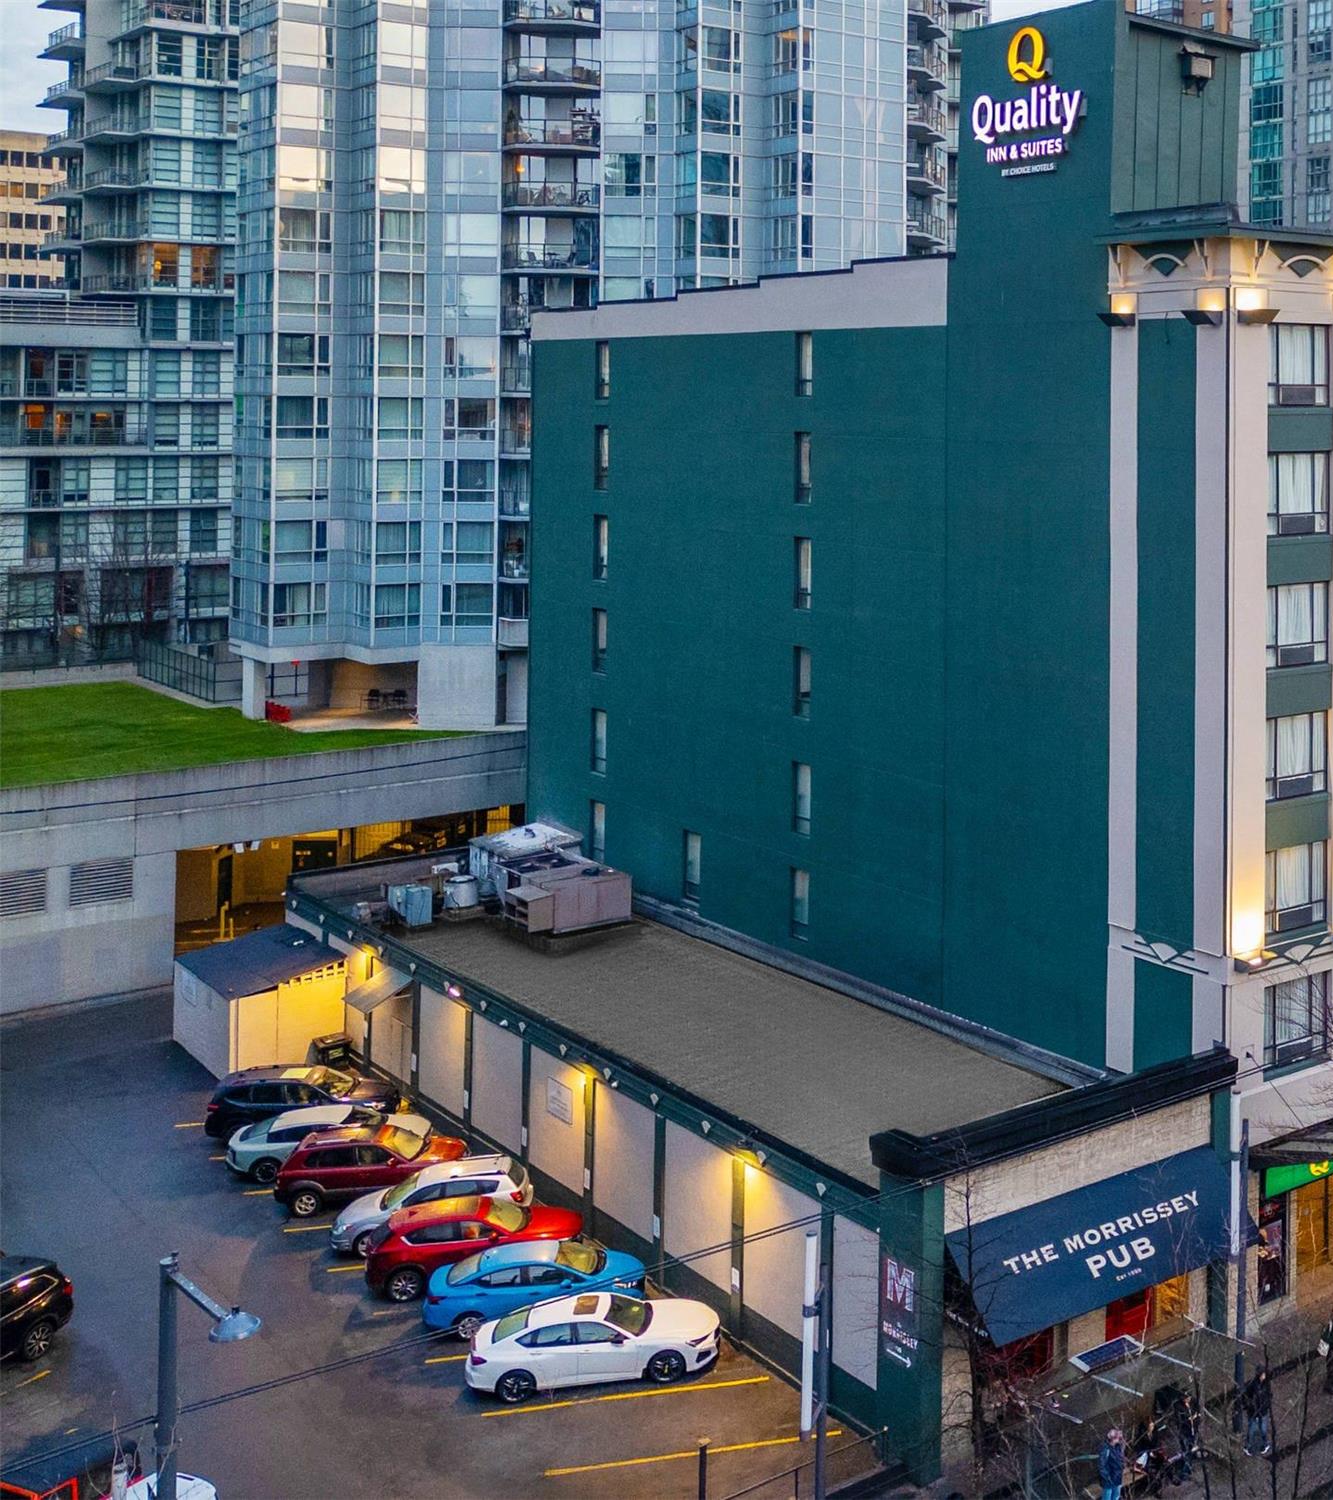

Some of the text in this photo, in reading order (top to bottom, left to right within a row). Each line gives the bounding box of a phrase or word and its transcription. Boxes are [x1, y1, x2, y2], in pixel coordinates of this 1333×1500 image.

[1008, 26, 1045, 82] Q
[972, 84, 1081, 145] Quality
[986, 138, 1063, 163] INN & SUITES
[1010, 165, 1032, 175] CHOICE
[1031, 162, 1055, 173] HOTELS
[1003, 1190, 1201, 1275] THE MORRISSEY
[1085, 1236, 1156, 1279] PUB
[886, 1258, 915, 1312] M
